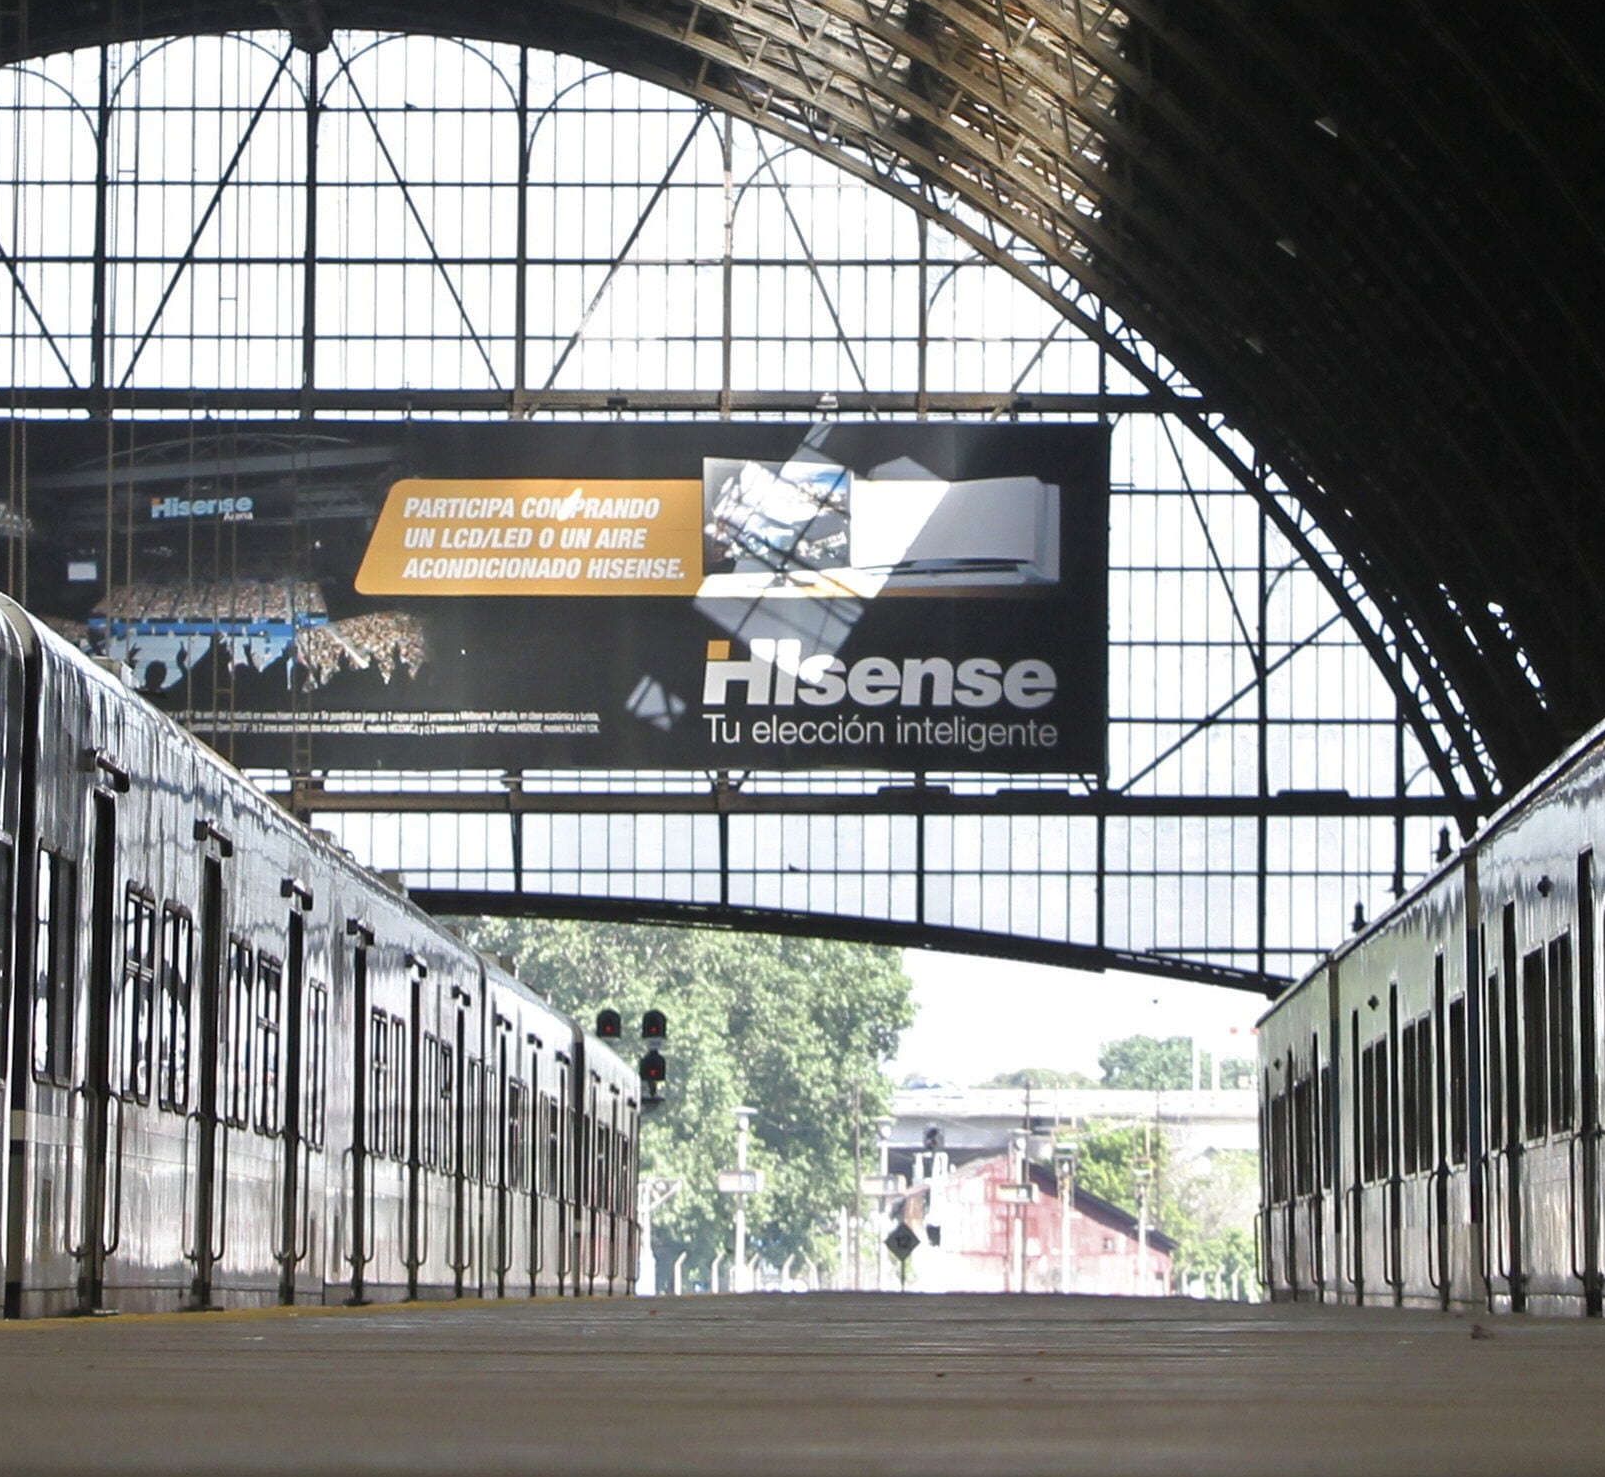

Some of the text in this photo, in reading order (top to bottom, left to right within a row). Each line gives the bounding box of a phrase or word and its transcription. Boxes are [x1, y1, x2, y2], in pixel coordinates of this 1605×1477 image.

[151, 496, 253, 519] Hisense
[403, 497, 514, 519] PARTICIPA
[403, 527, 647, 550] UN LCD/LED O UN AIRE
[402, 558, 685, 580] ACONDICIONADO HISENSE.
[702, 638, 1058, 709] Hisense
[702, 713, 1059, 753] Tu elección inteligente
